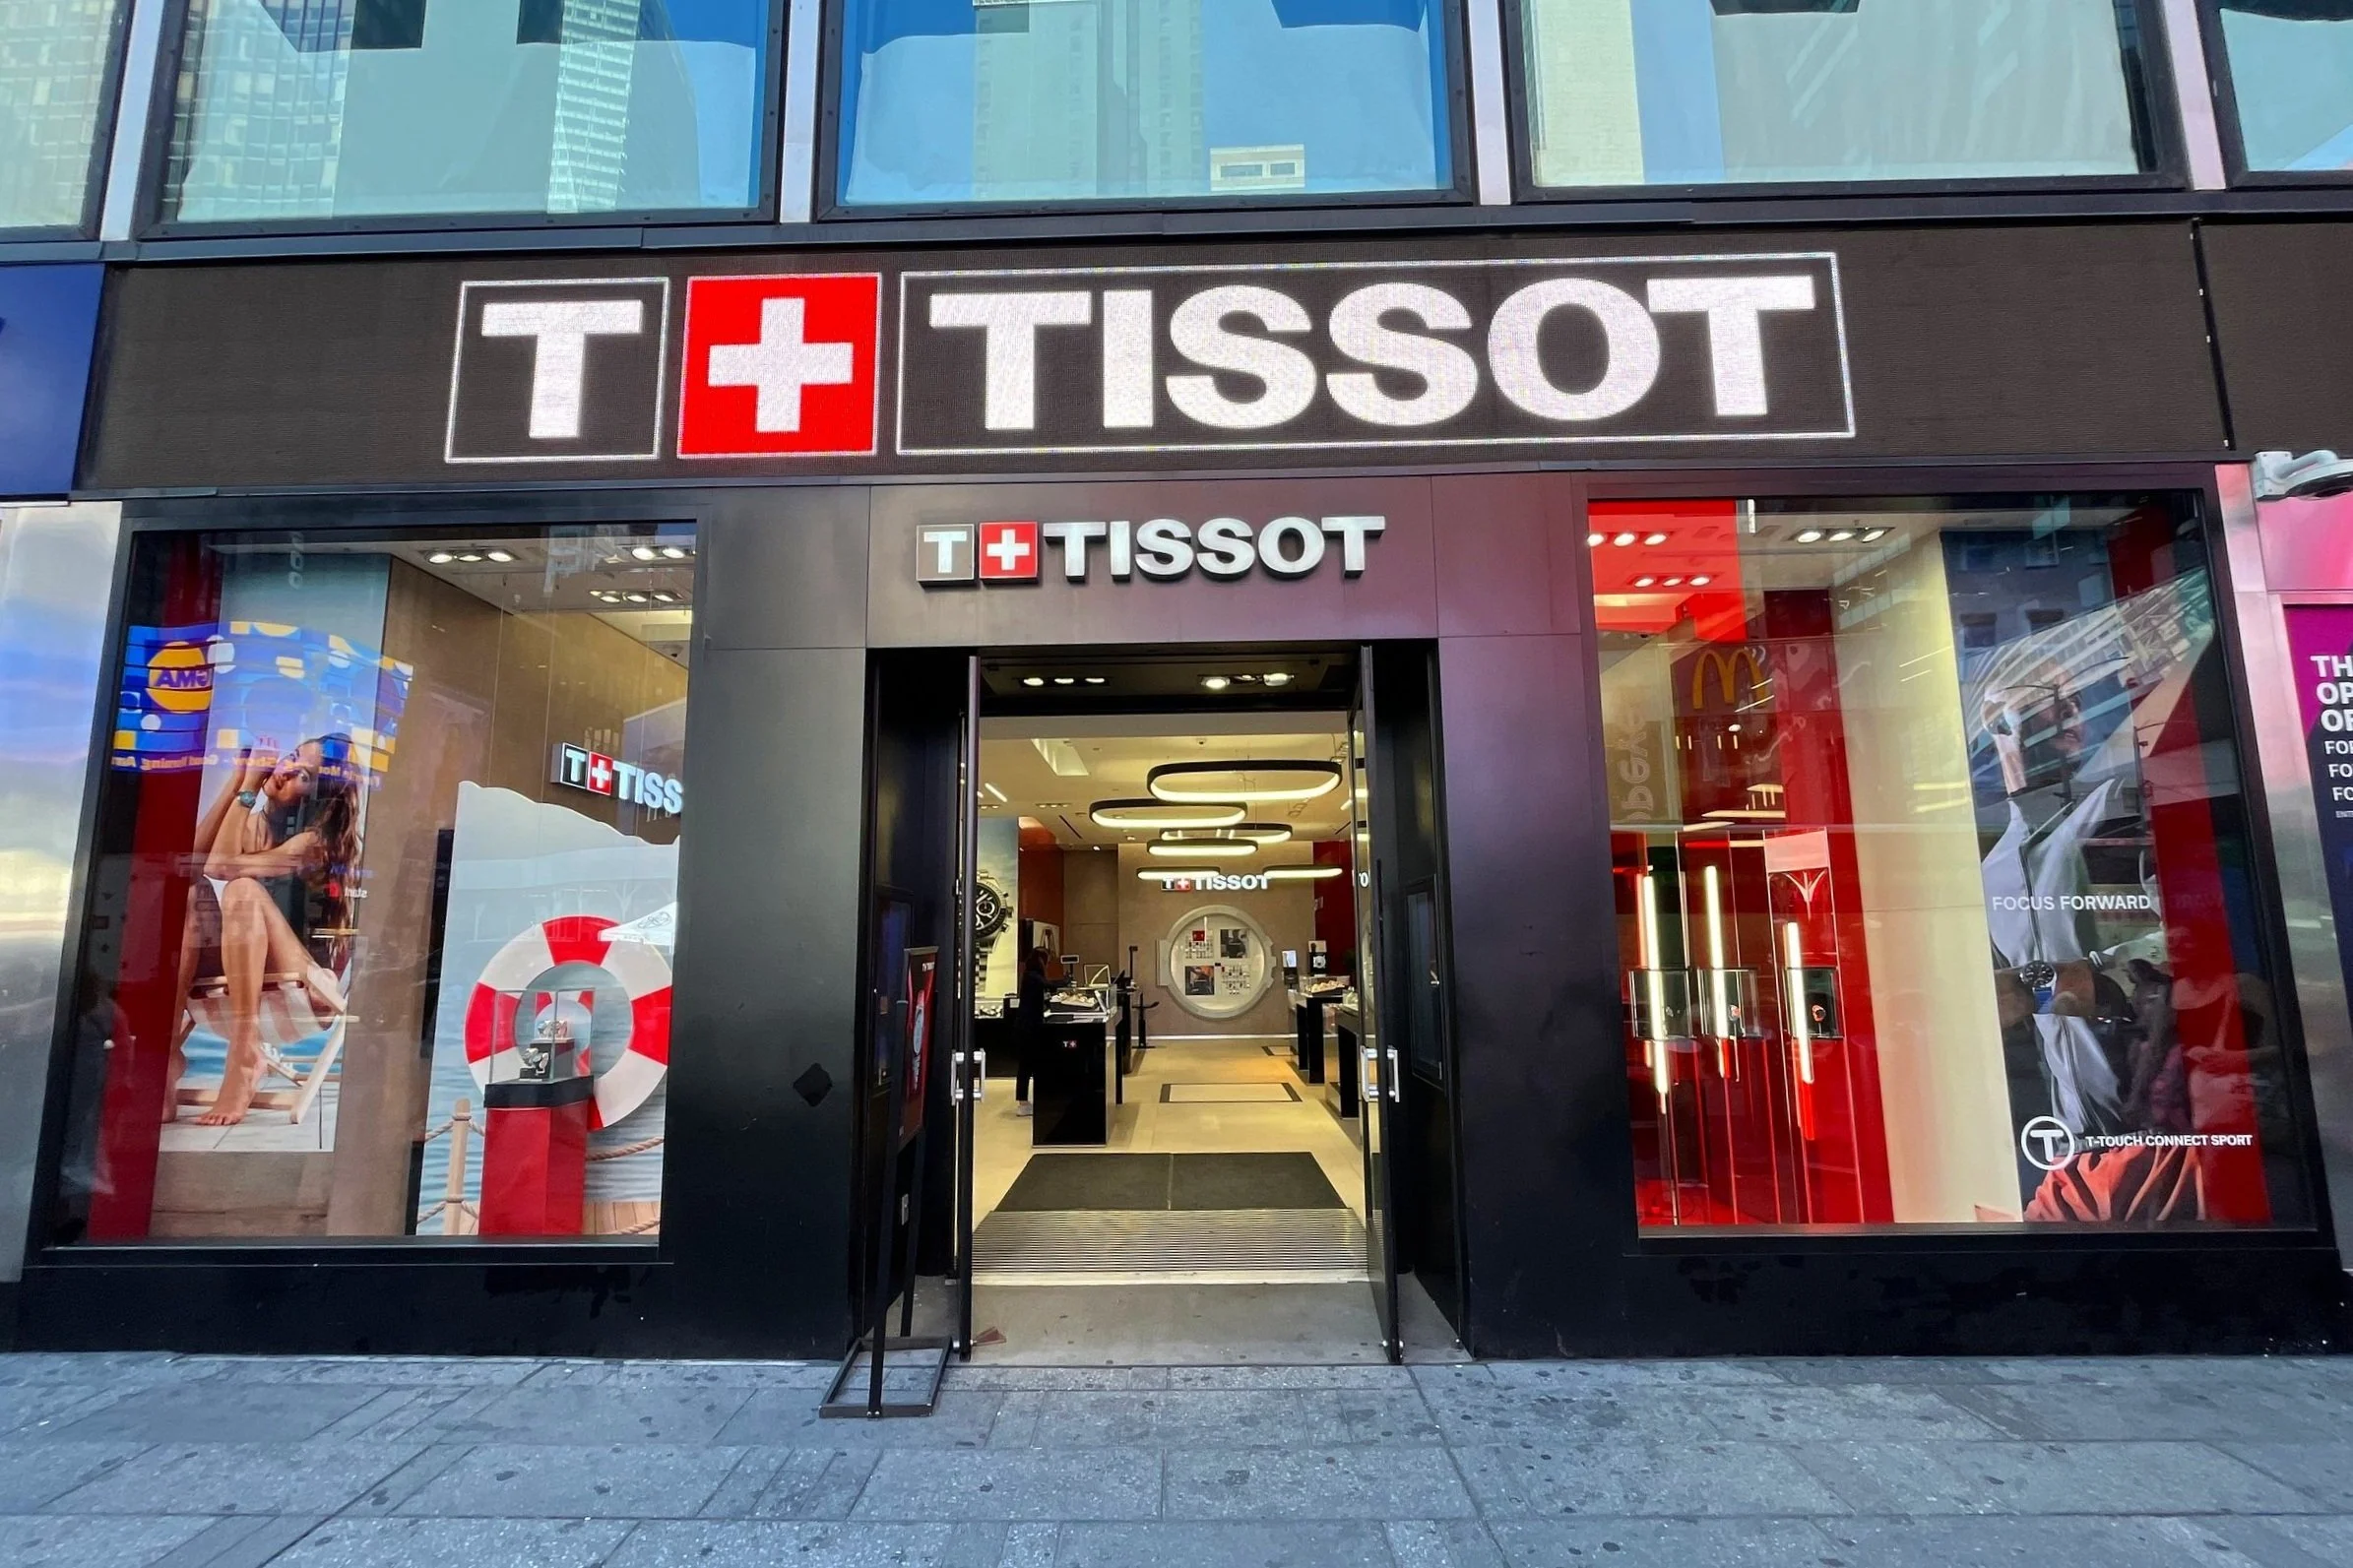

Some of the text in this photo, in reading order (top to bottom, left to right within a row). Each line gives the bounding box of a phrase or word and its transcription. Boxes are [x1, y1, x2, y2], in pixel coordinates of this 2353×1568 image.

[481, 276, 1815, 438] T TISSOT
[923, 516, 1386, 582] T TISSOT
[612, 760, 682, 813] TISS
[1194, 873, 1268, 891] TISSOT
[1993, 896, 2056, 911] FOCUS
[2060, 895, 2151, 910] FORWARD
[2085, 1134, 2254, 1148] T-TOUCH CONNECT SPORT
